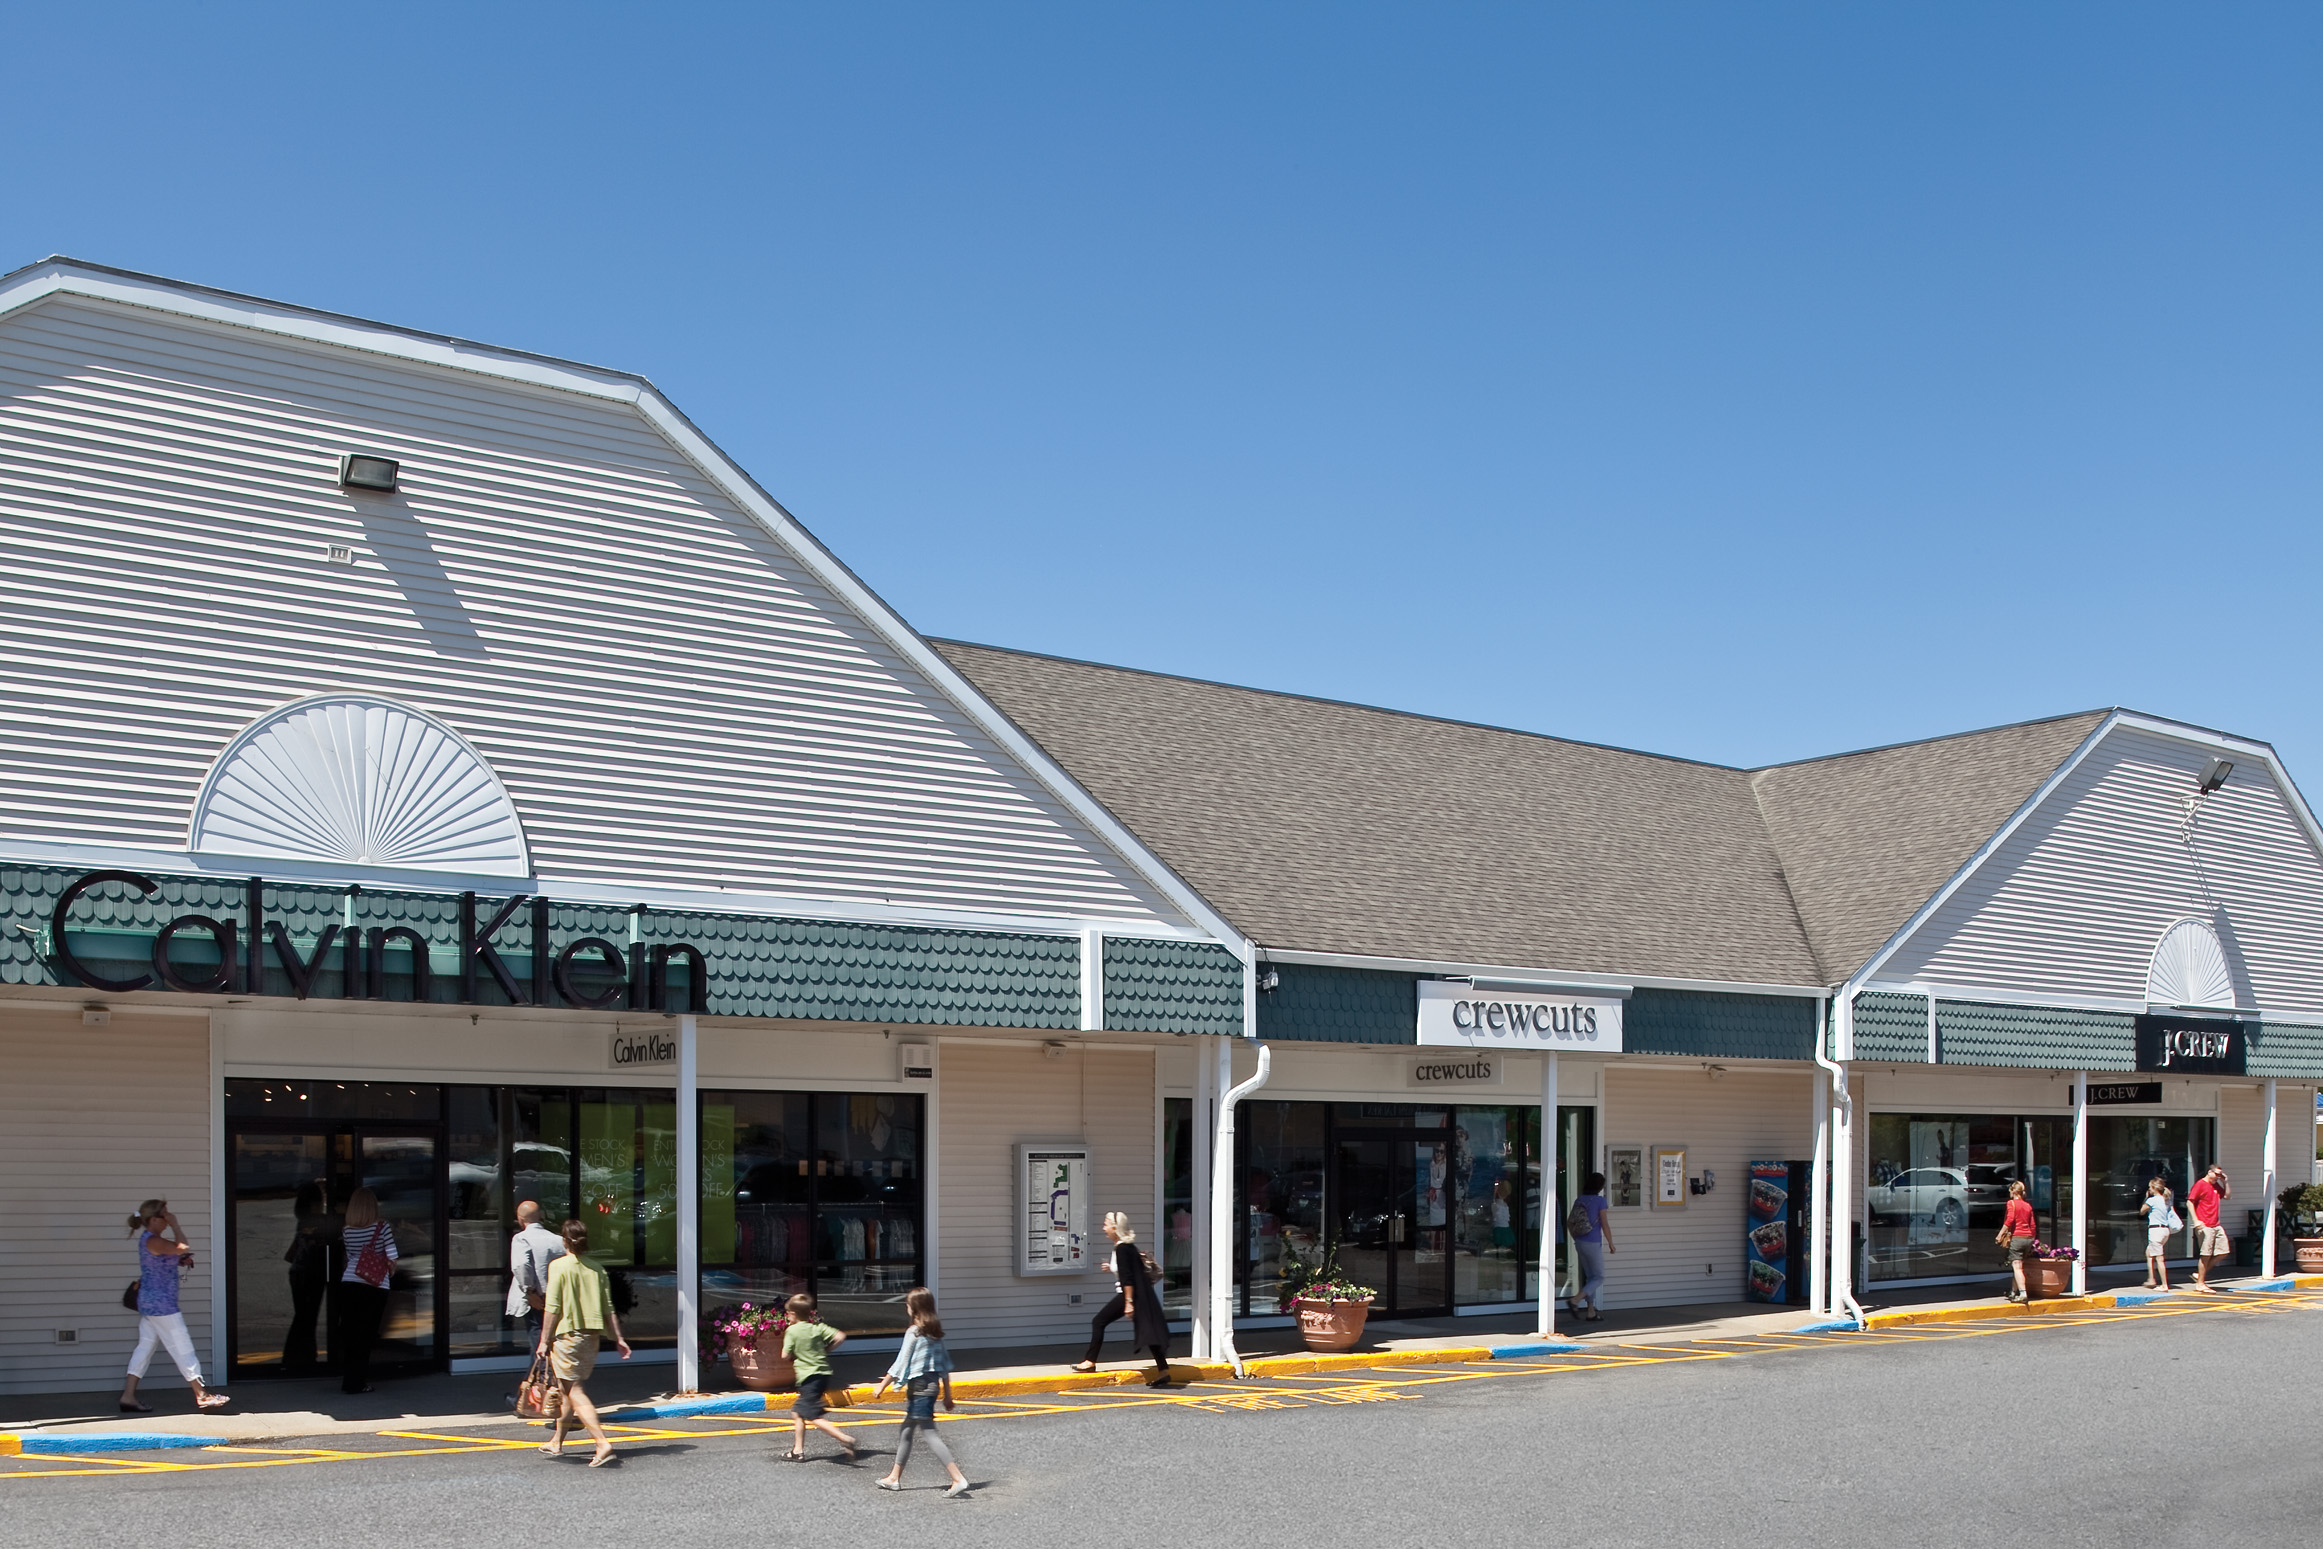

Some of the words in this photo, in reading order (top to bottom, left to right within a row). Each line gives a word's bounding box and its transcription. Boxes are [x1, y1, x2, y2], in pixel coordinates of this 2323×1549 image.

[52, 870, 429, 1000] Calvin
[459, 891, 708, 1012] Klein
[1453, 999, 1597, 1034] crewcuts
[613, 1036, 648, 1064] Calvin
[649, 1032, 677, 1061] Klein
[2158, 1029, 2230, 1067] J.CREW
[1415, 1060, 1492, 1081] crewcuts
[2089, 1086, 2139, 1105] J.CREW
[588, 1138, 625, 1151] STOCK
[591, 1183, 623, 1199] OFF
